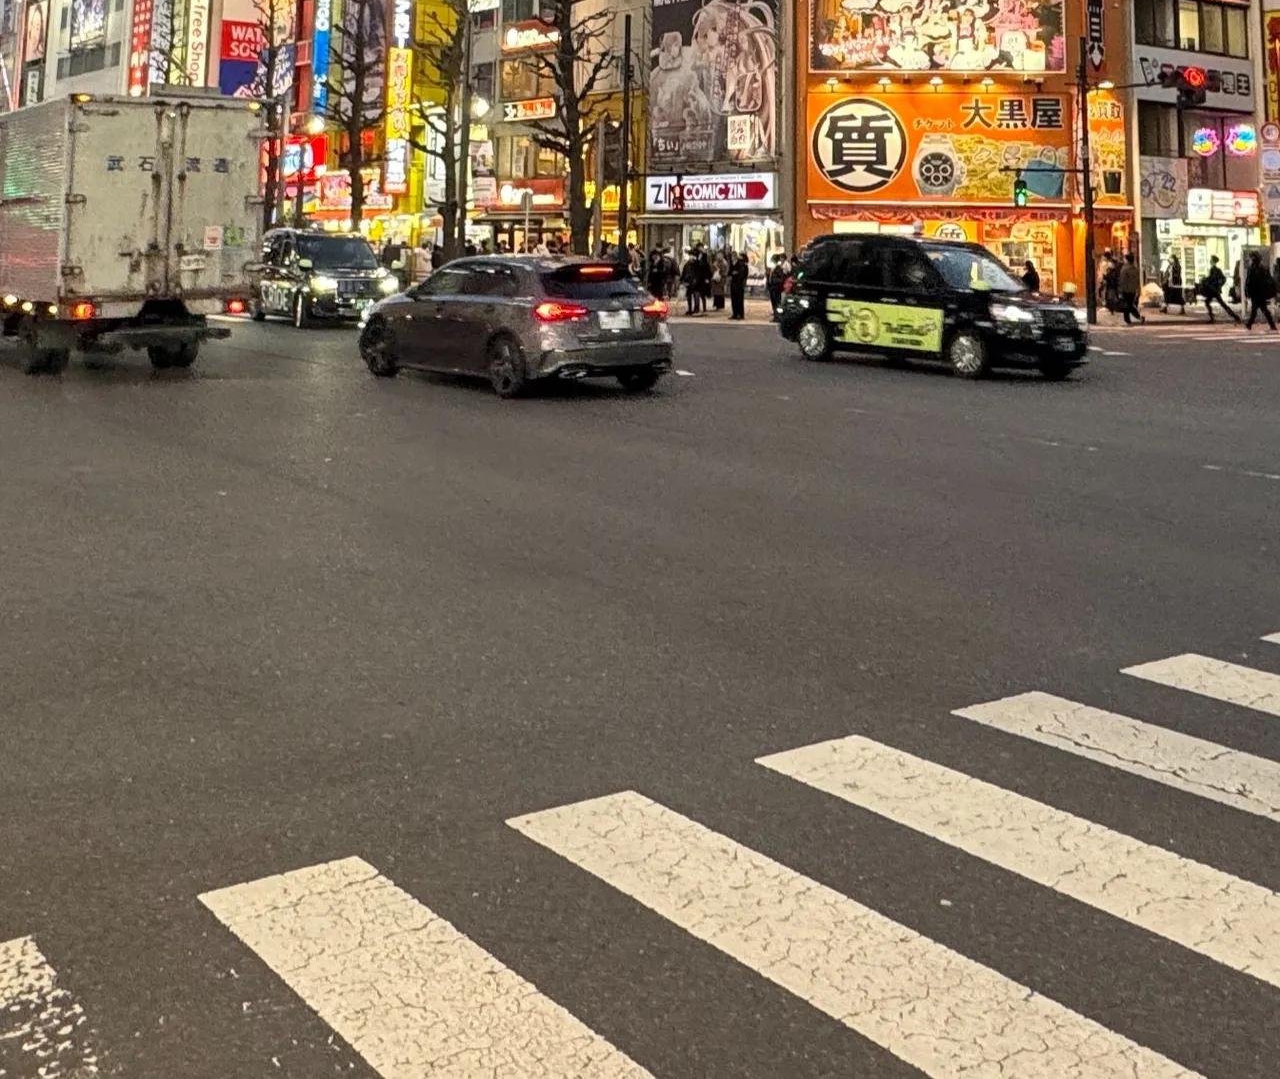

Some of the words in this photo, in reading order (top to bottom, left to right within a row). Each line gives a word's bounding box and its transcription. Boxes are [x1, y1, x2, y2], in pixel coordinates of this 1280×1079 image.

[186, 40, 205, 83] Shop
[914, 119, 954, 131] チケット
[961, 96, 1064, 130] 大黒屋
[824, 113, 898, 180] 質
[683, 183, 726, 201] COMIC
[727, 182, 748, 199] ZIN
